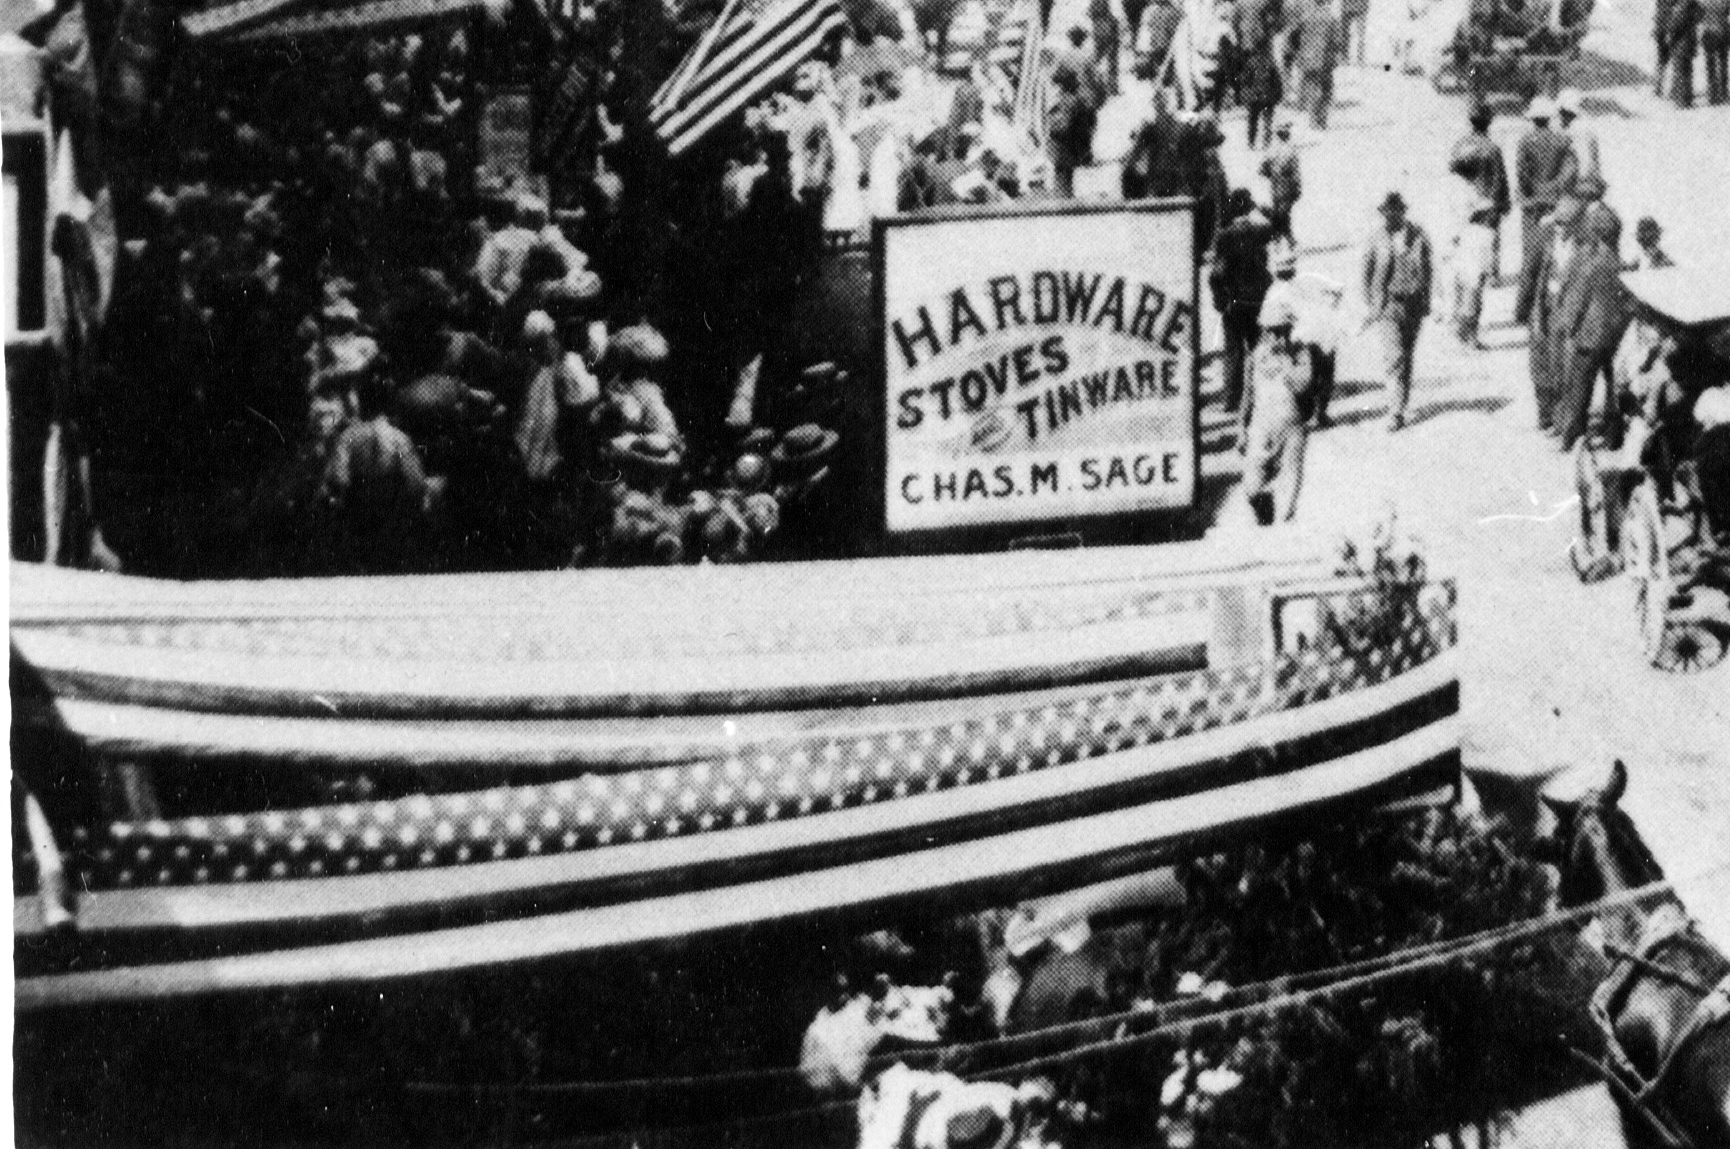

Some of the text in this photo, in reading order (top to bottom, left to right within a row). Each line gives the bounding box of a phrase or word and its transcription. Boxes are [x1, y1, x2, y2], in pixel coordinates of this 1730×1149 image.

[892, 270, 1198, 369] HARDWARE
[898, 335, 1069, 429] STOVES
[1016, 359, 1180, 443] TINWARE
[1079, 452, 1180, 493] SAGE
